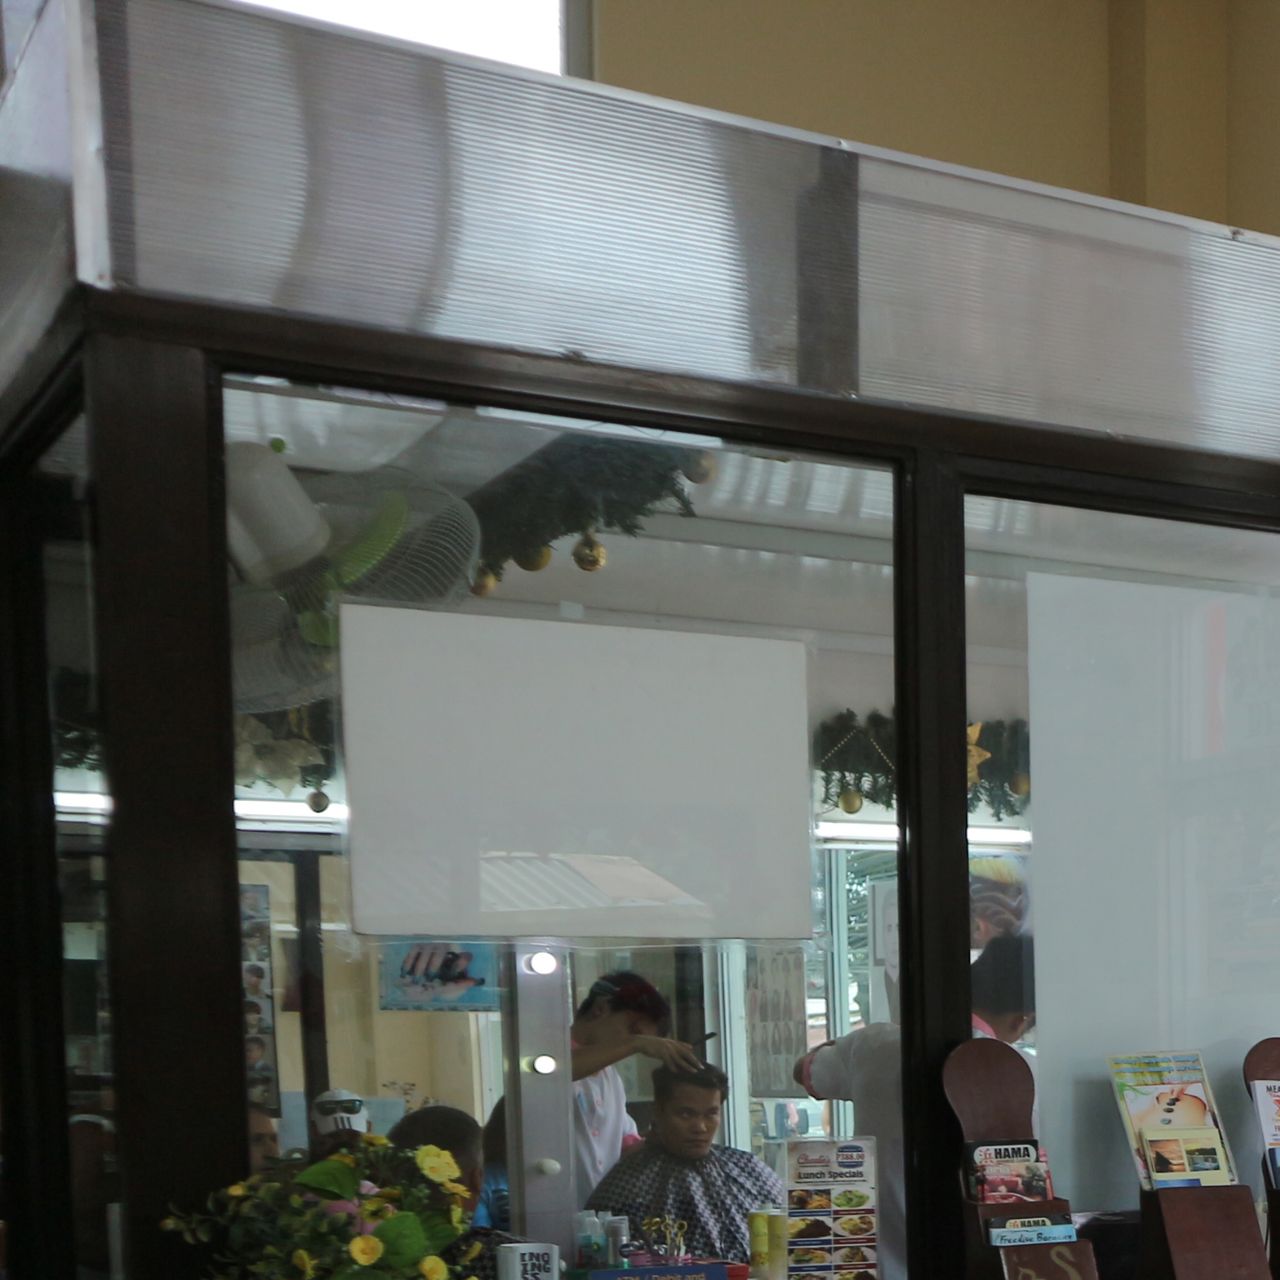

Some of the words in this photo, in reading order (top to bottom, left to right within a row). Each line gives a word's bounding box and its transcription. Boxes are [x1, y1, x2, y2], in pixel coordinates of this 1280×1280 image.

[994, 1146, 1031, 1160] HAMA
[798, 1170, 825, 1180] Lunch
[828, 1169, 864, 1180] Specials
